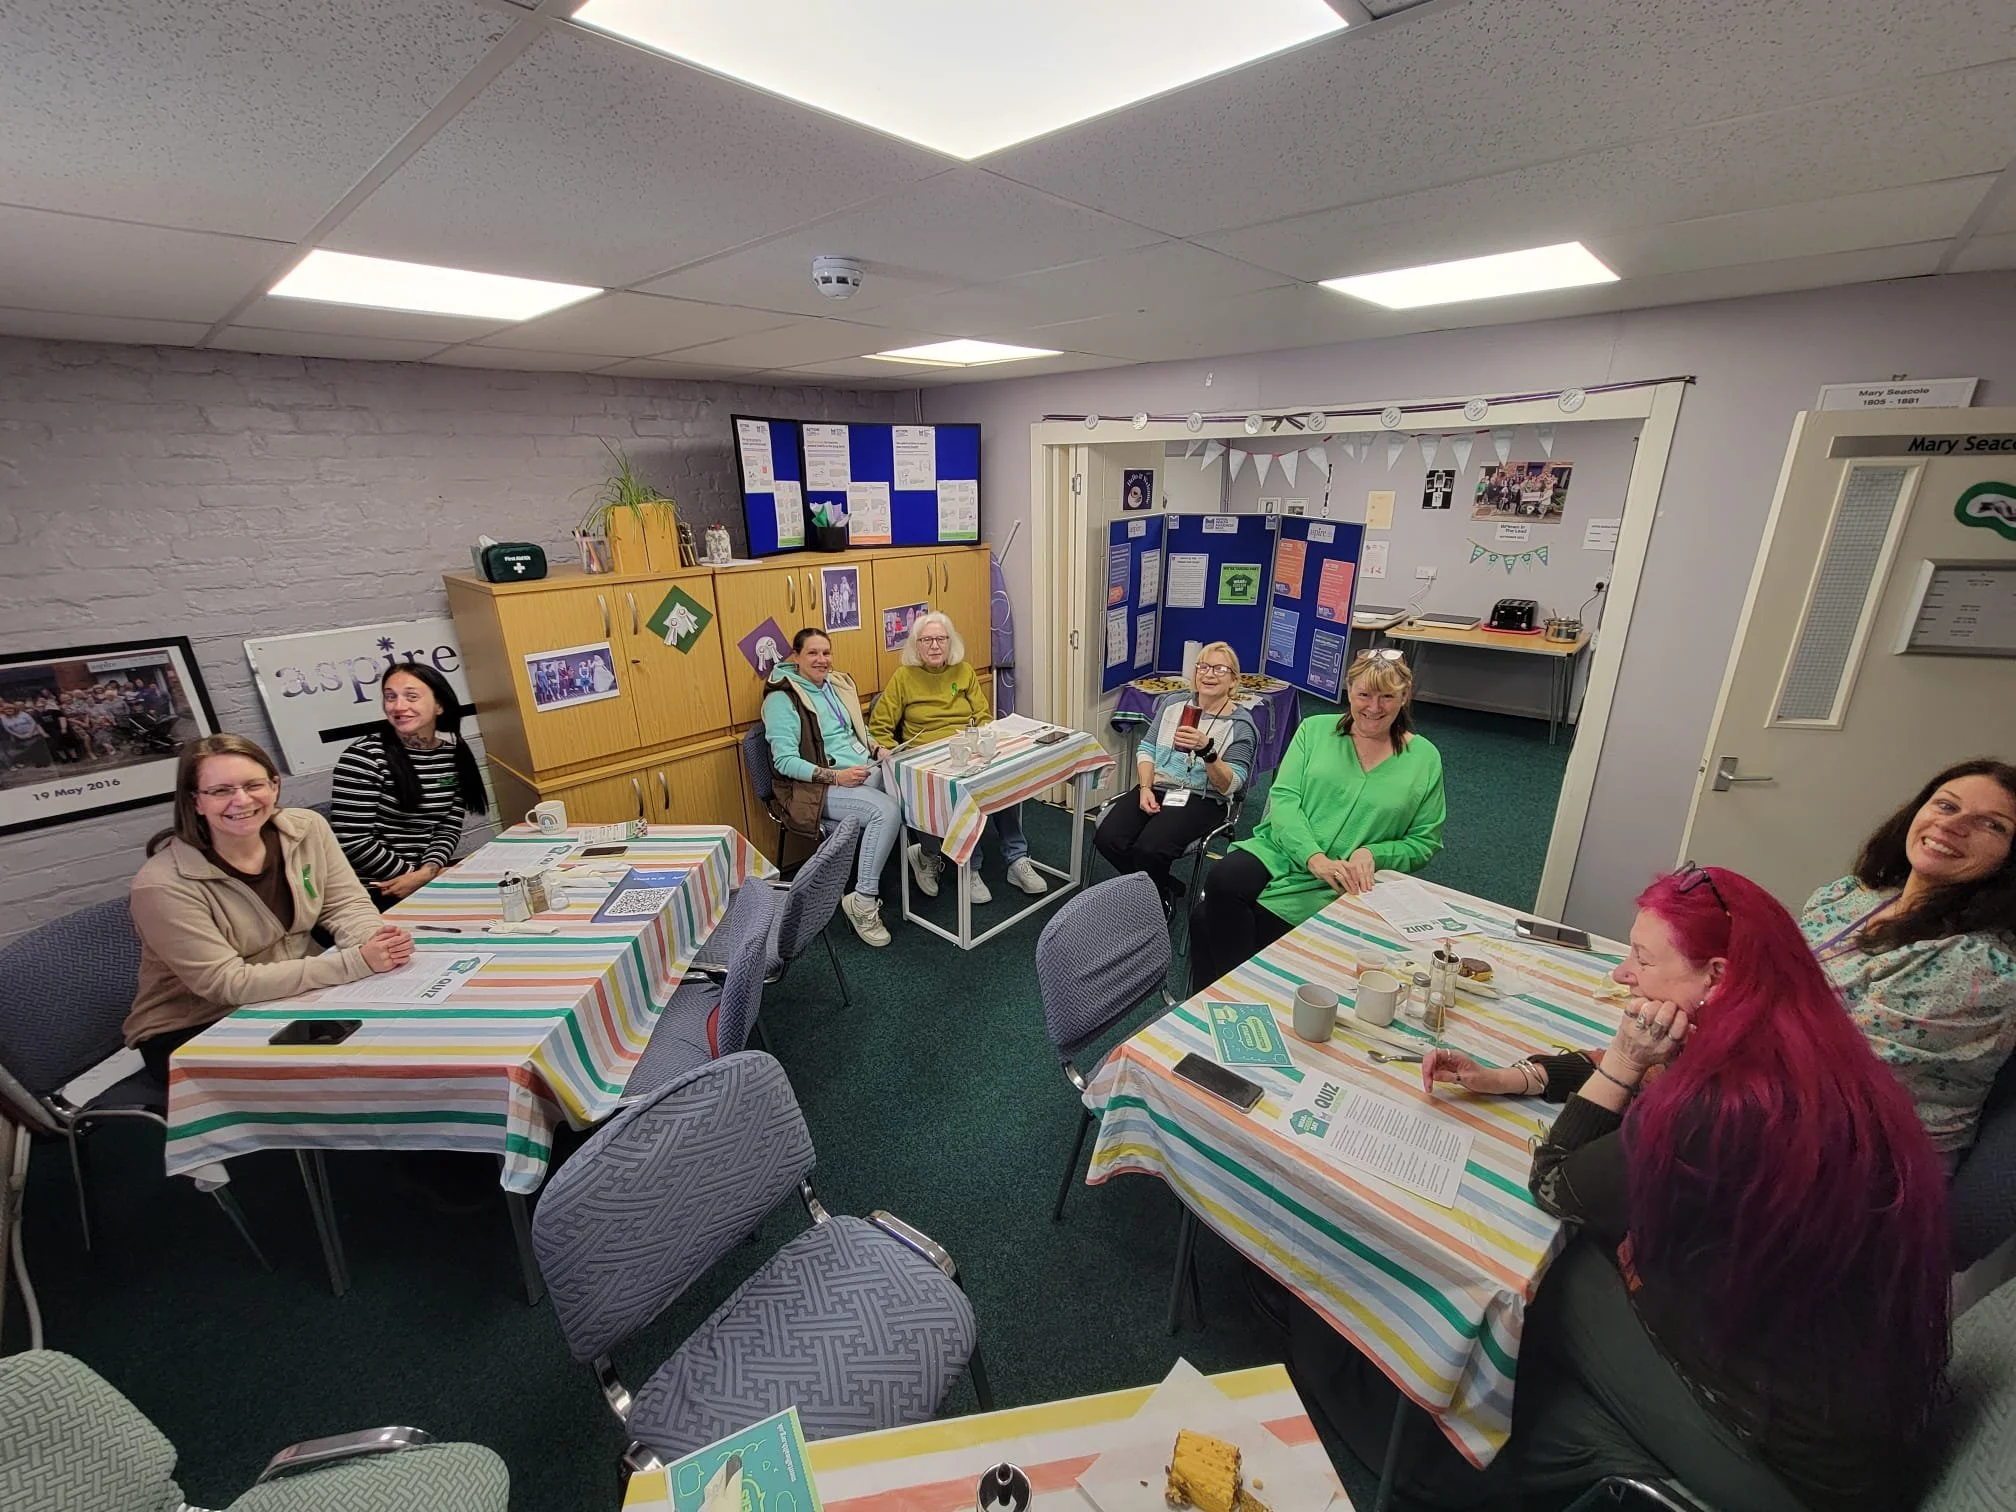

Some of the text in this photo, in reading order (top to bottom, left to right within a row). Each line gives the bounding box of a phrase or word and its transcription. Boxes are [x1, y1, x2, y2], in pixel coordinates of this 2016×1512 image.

[1887, 388, 1930, 396] Seacole
[1907, 436, 1960, 455] Mary
[275, 636, 461, 704] aspire
[32, 779, 121, 801] 19 May 2016
[1402, 924, 1434, 934] QUIZ
[421, 978, 453, 999] QUIZ
[1314, 1081, 1340, 1109] QUIZ
